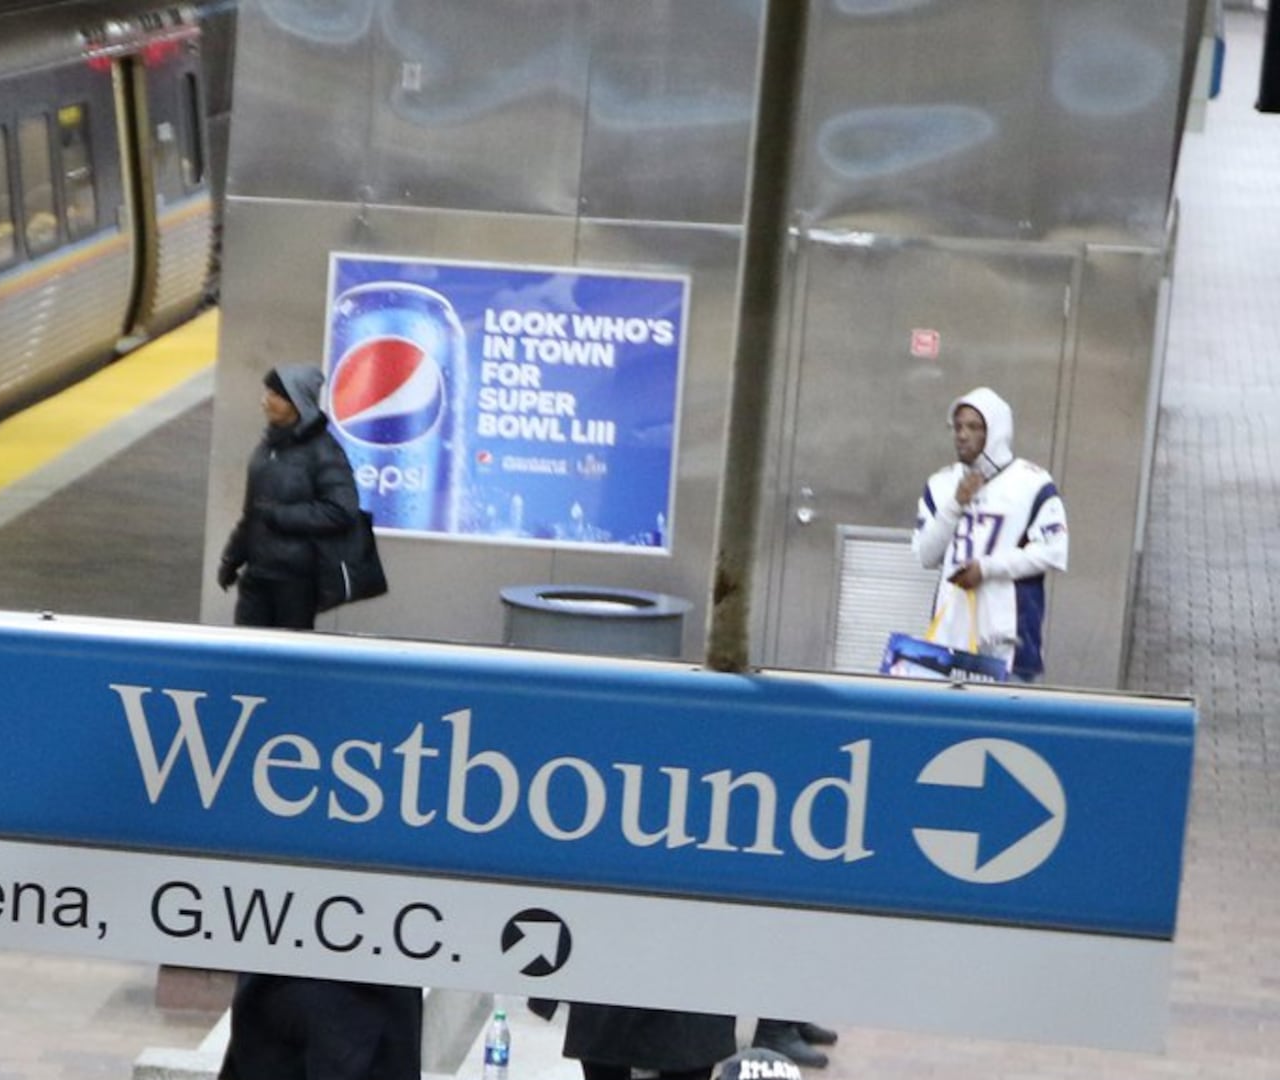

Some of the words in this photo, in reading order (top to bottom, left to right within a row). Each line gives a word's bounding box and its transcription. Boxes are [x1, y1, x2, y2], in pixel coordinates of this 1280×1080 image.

[484, 308, 568, 337] LOOK
[572, 314, 674, 346] WHO'S
[483, 335, 515, 360] IN
[521, 337, 615, 367] TOWN
[481, 360, 540, 388] FOR
[478, 387, 576, 416] SUPER
[477, 412, 566, 442] BOWL
[571, 420, 616, 446] LIII
[354, 464, 429, 496] epsi
[952, 512, 1004, 566] 87
[108, 684, 873, 862] Westbound
[151, 881, 460, 962] G.W.C.C.
